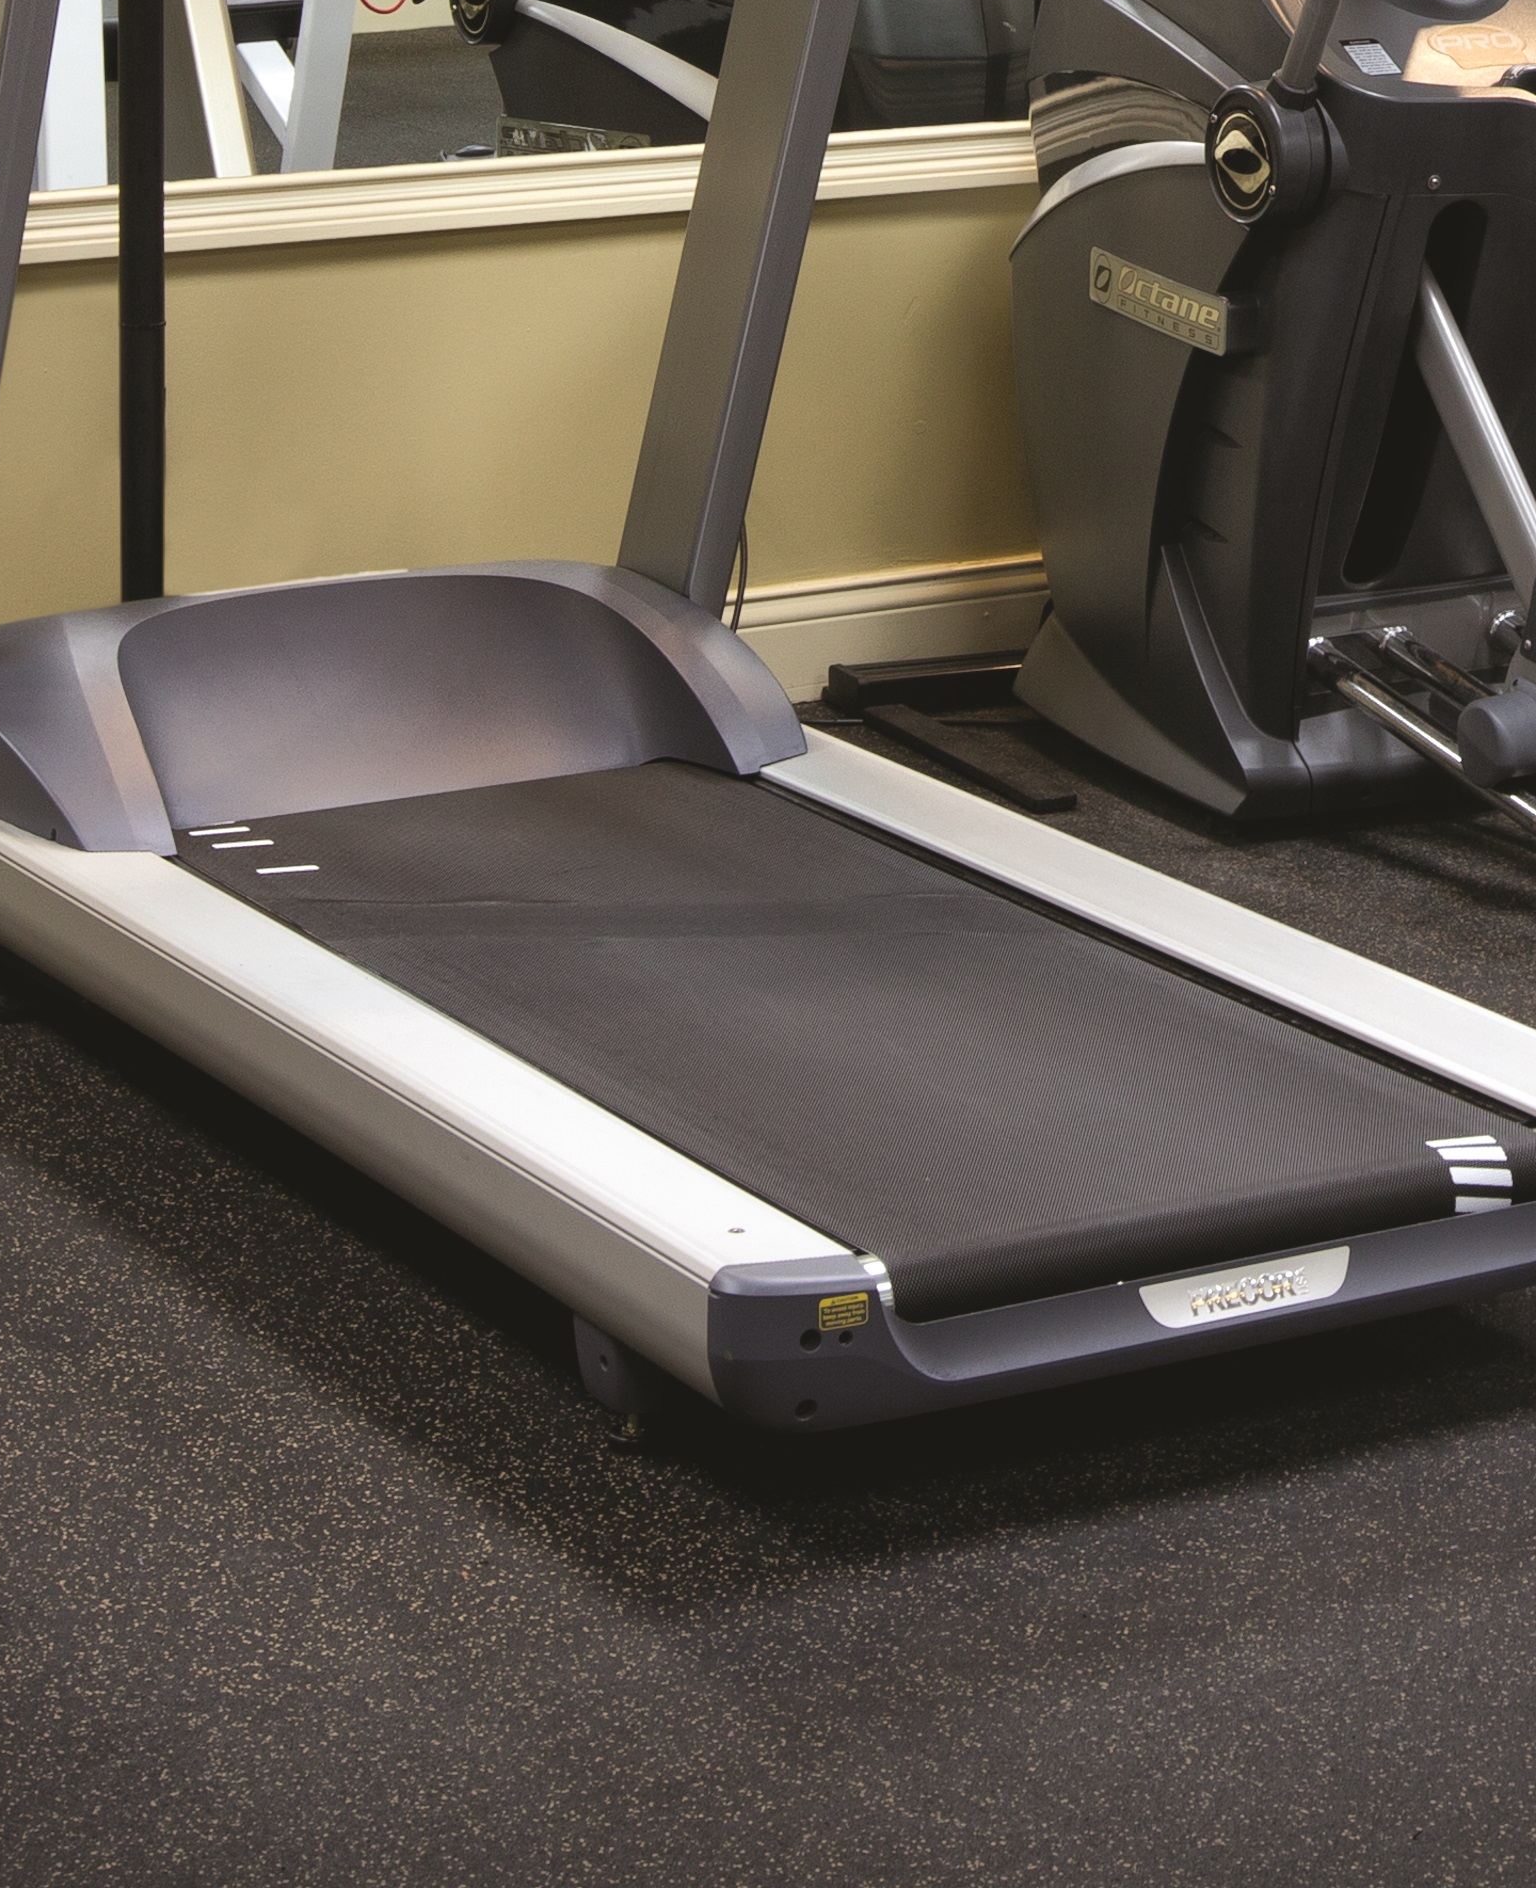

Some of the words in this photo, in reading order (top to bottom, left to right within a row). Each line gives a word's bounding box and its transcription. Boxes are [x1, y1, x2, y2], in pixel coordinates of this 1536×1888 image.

[1436, 31, 1515, 51] PRO
[1118, 265, 1220, 329] Octane
[1120, 299, 1212, 345] FITNESS
[1187, 1270, 1297, 1317] PRECOR
